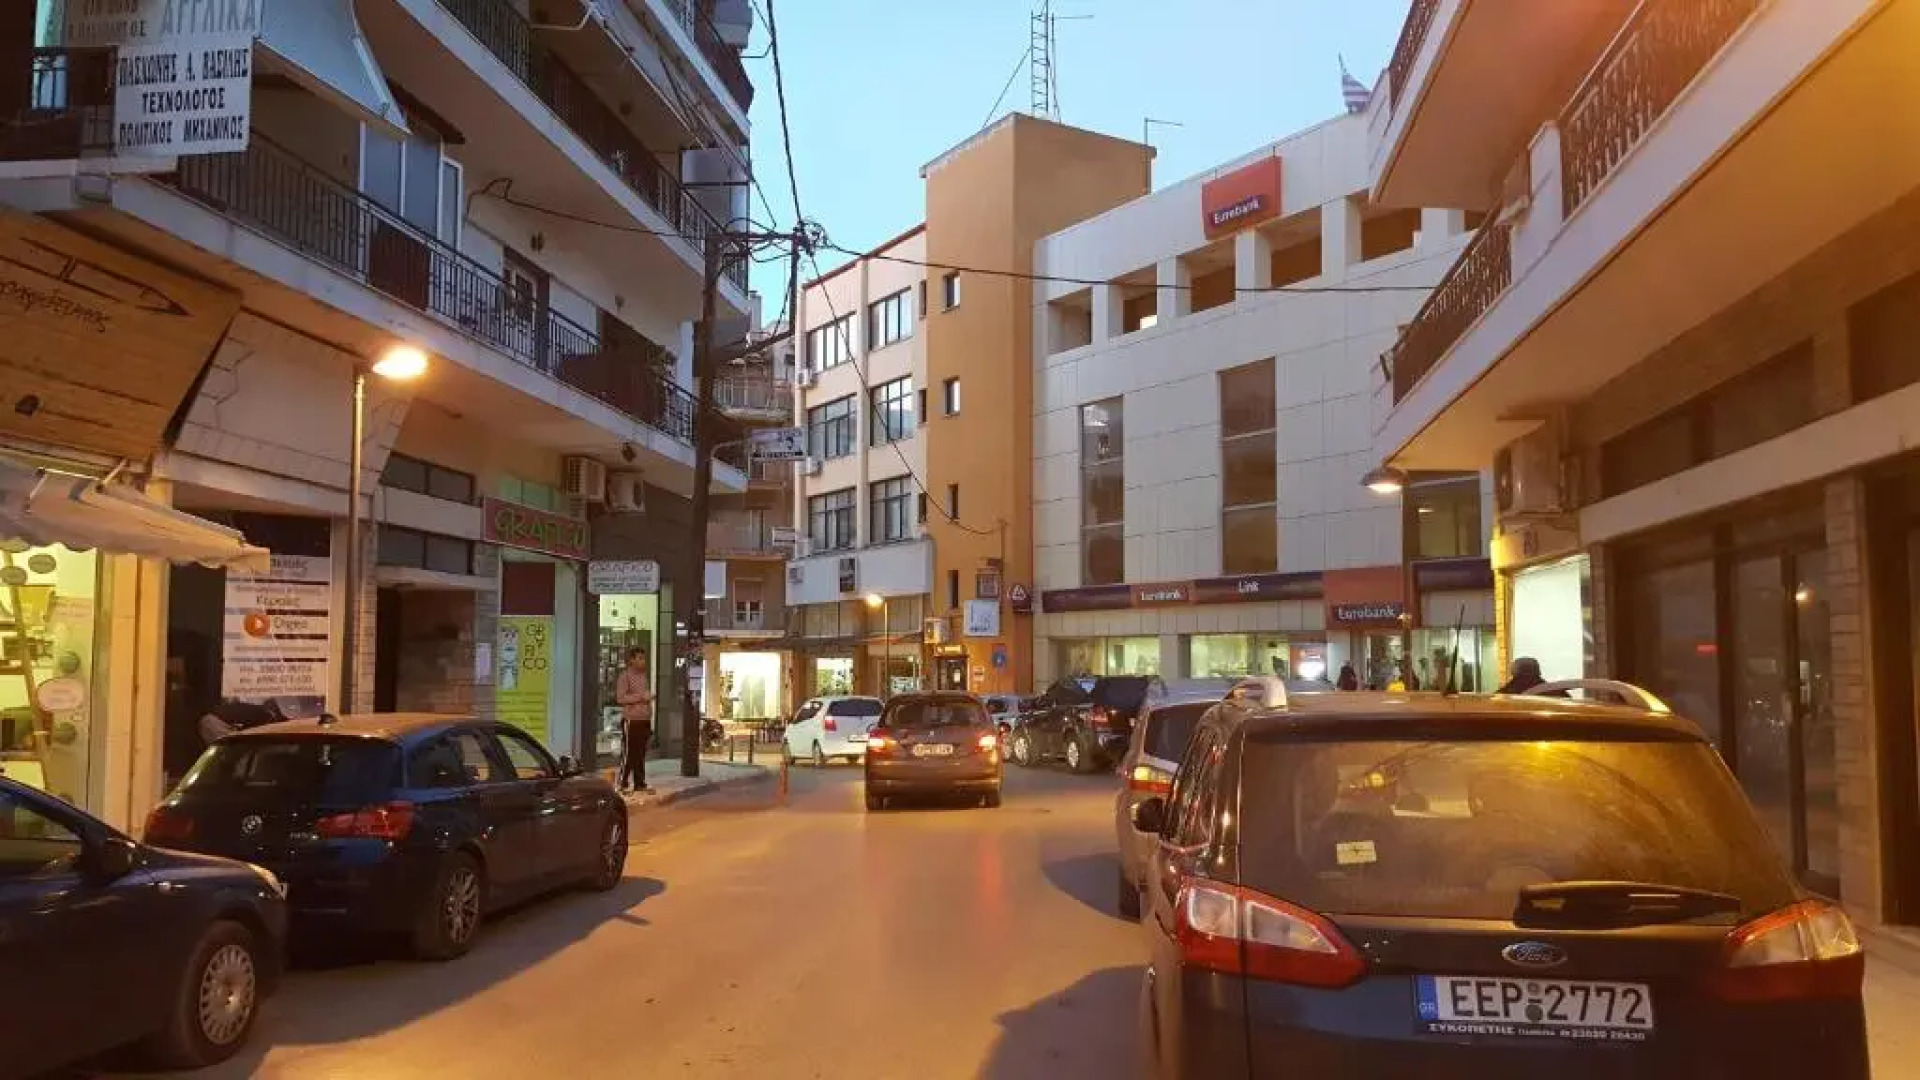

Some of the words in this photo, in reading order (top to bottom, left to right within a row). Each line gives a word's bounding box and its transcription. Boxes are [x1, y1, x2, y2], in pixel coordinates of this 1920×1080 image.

[142, 87, 226, 115] ΤΕΧΝΟΛΟΓΟΣ
[119, 121, 173, 147] ΠΟΛΙΤΙΚΟΣ
[183, 115, 245, 142] ΜΗΧΑΝΙΚΟΣ
[1214, 197, 1260, 224] Eurobank
[1238, 579, 1259, 593] Link
[1338, 605, 1397, 620] Eurobank
